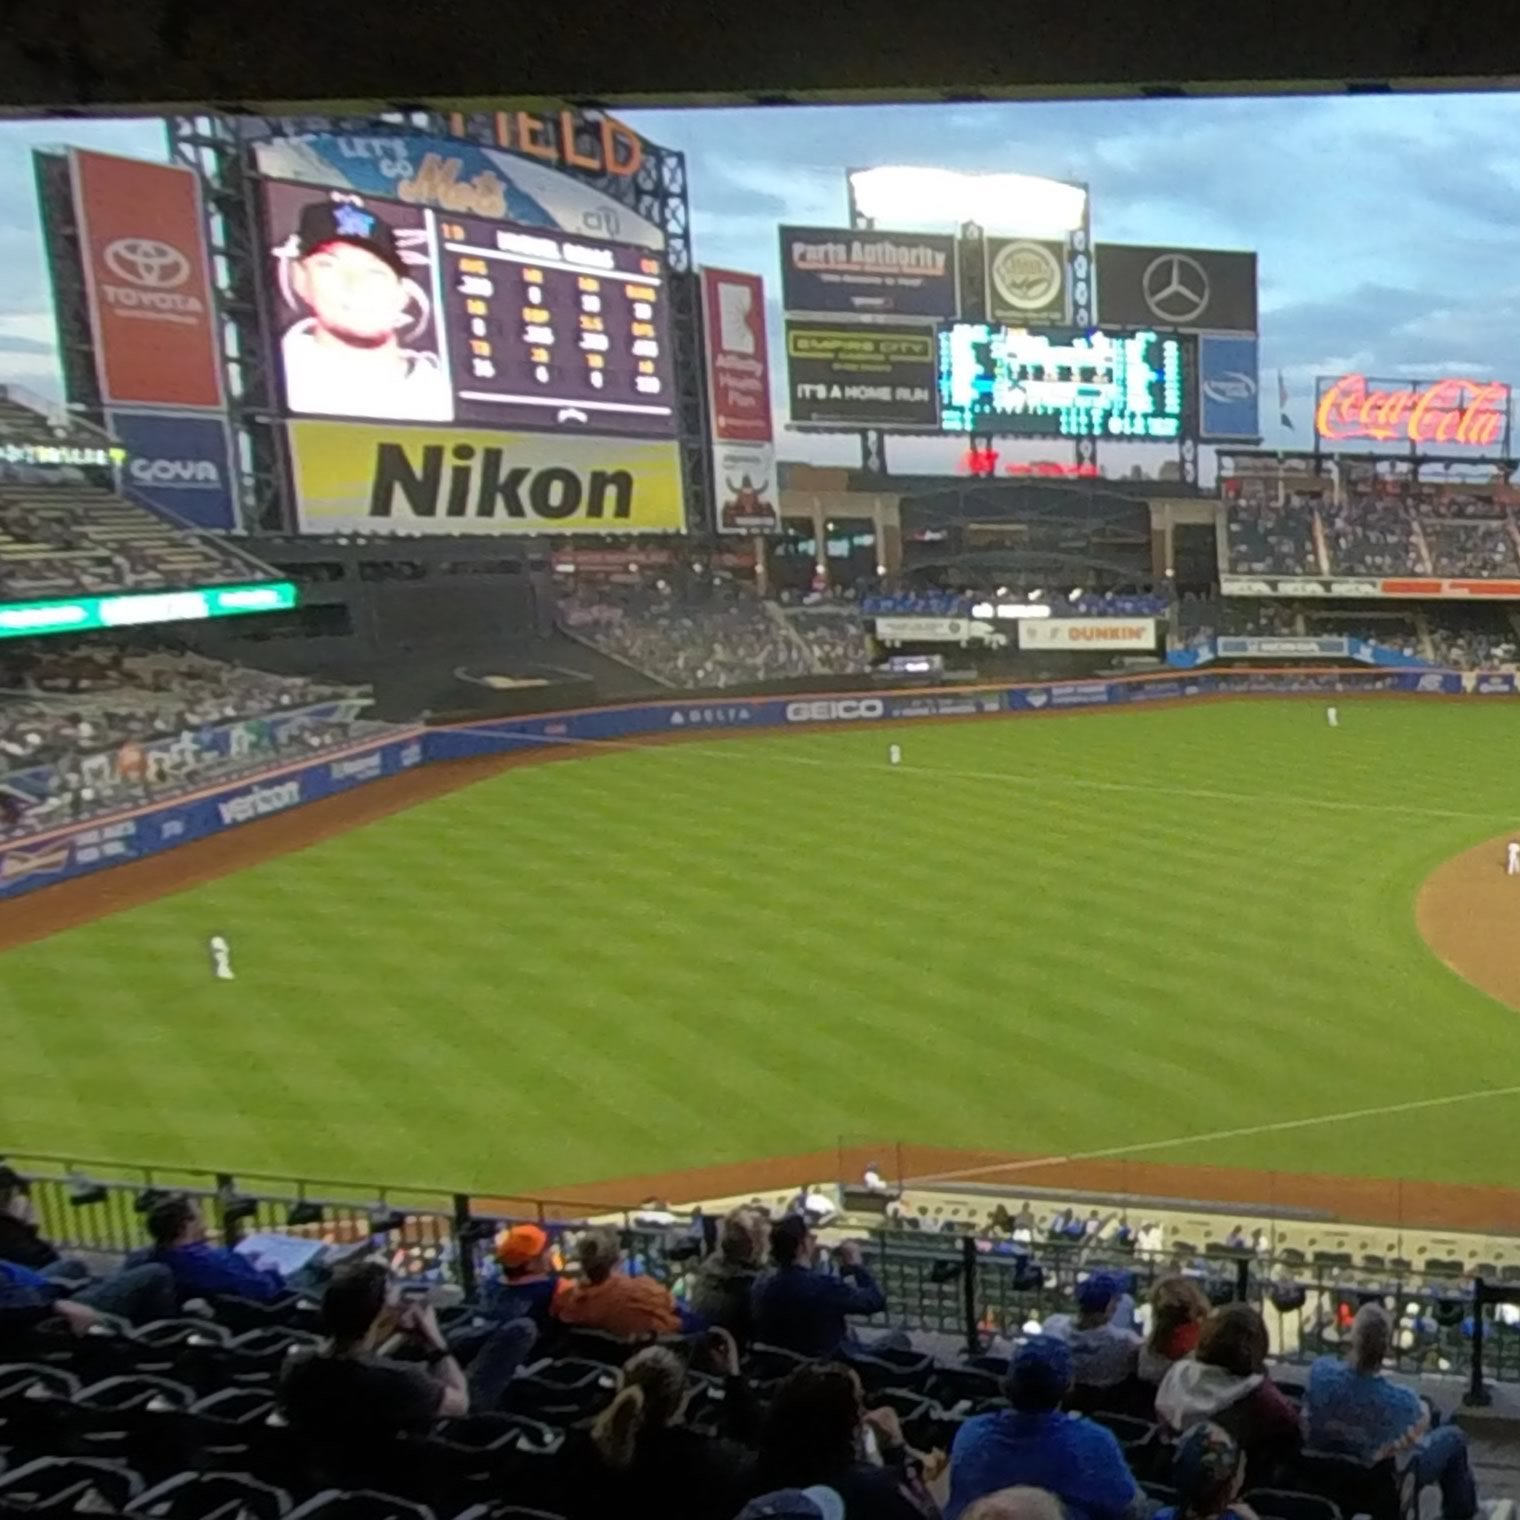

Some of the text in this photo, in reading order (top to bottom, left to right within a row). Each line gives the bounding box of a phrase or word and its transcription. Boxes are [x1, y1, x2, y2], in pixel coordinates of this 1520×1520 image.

[791, 240, 946, 270] Parts Authority
[102, 283, 204, 313] TOYOTA
[797, 383, 930, 403] IT'S A HOME RUN
[1316, 374, 1508, 447] Coca-Cola
[130, 458, 218, 481] GOYA
[368, 442, 634, 520] Nikon
[689, 709, 750, 725] DELTA
[786, 699, 884, 722] GEICO
[218, 779, 301, 826] verizon
